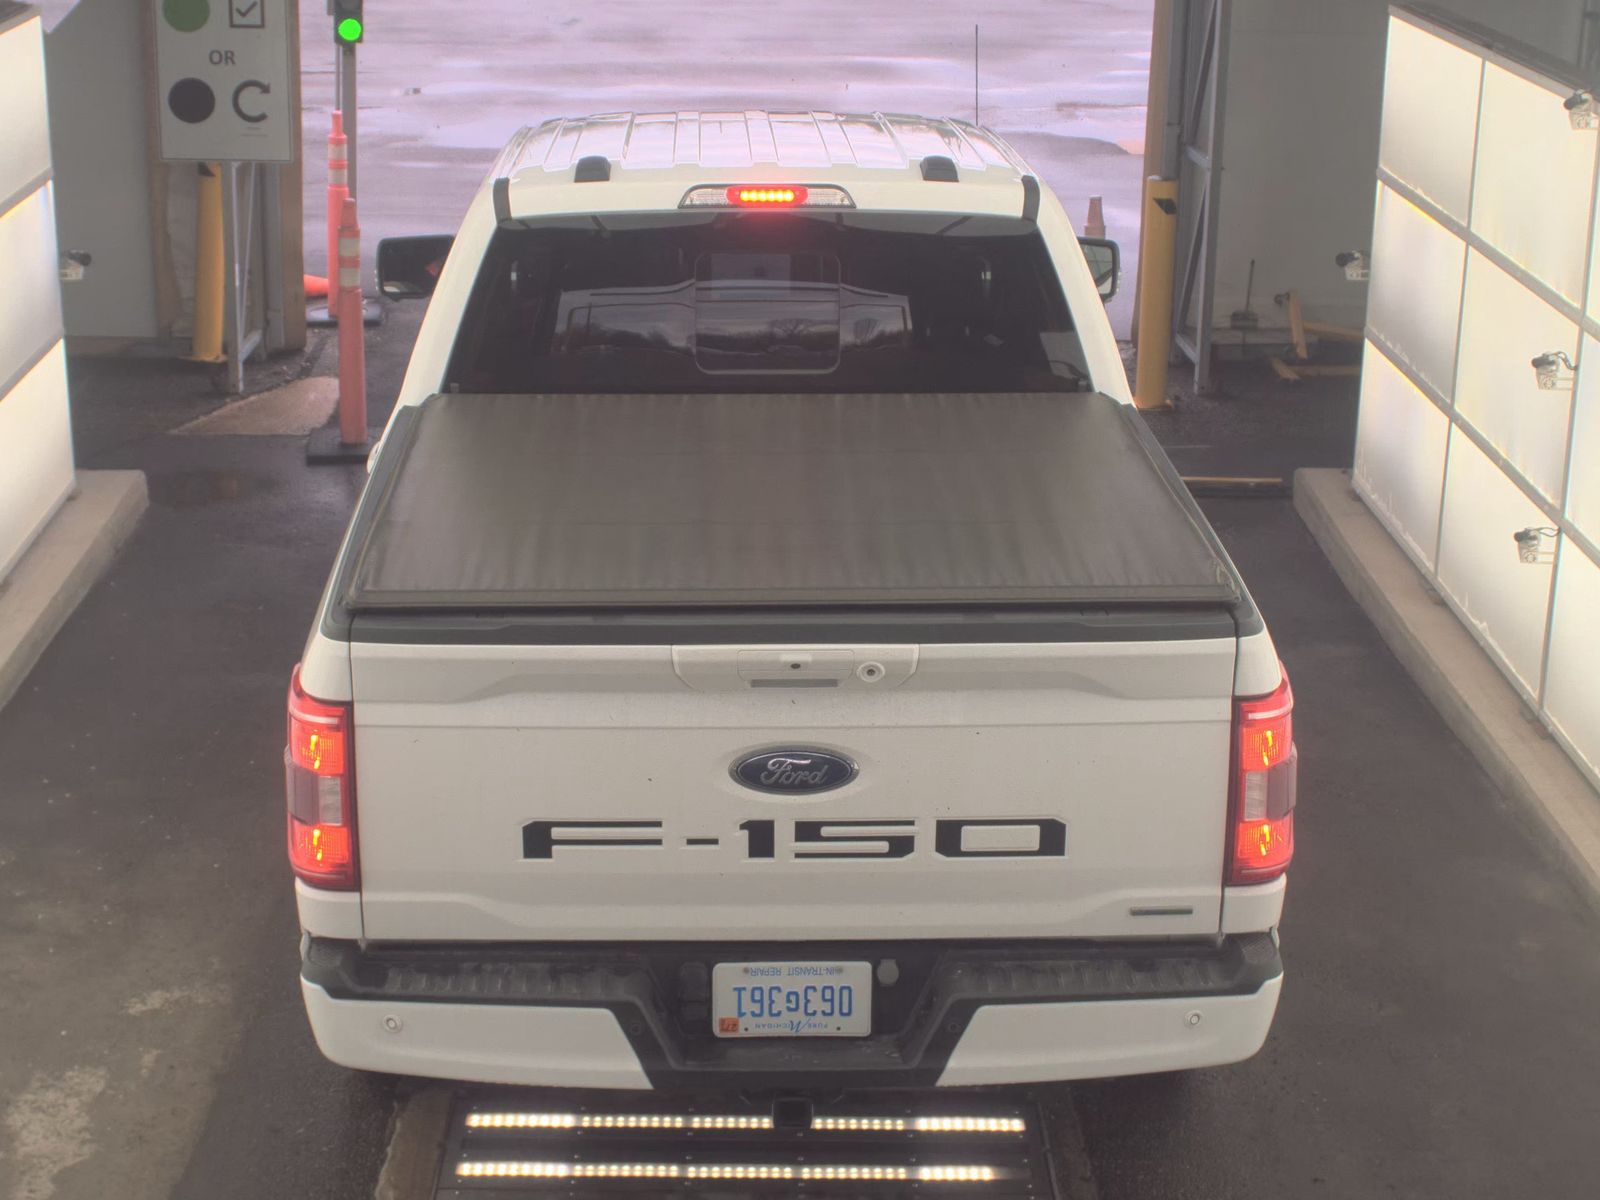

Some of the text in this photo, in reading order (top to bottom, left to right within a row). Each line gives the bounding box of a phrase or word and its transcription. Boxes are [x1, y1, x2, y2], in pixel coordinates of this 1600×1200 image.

[208, 49, 236, 66] OR
[760, 757, 829, 785] Ford
[522, 818, 1066, 859] F-150
[750, 966, 836, 977] IN-TRANSIT REPAIR
[732, 985, 853, 1018] 063G361
